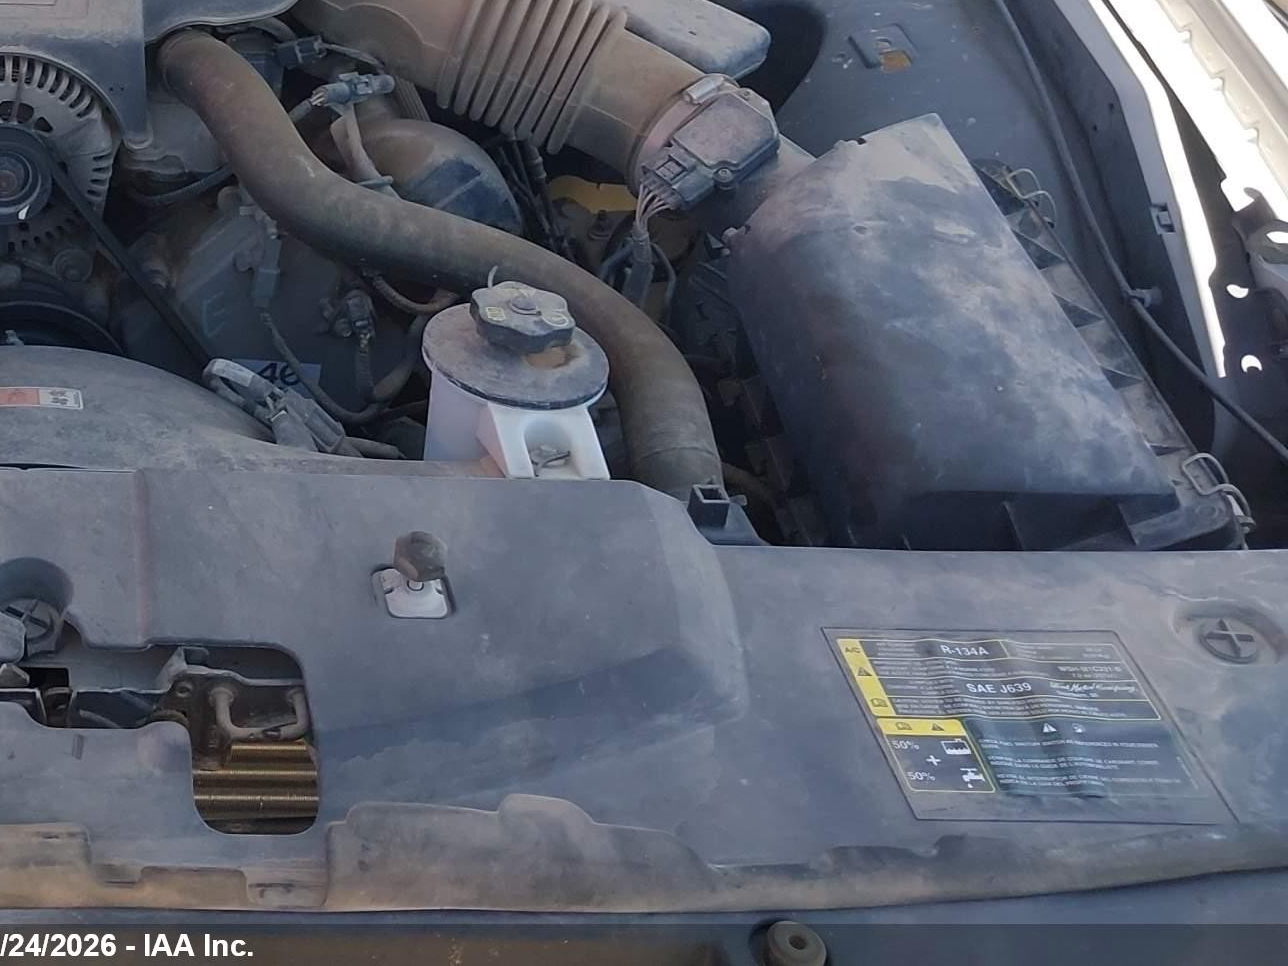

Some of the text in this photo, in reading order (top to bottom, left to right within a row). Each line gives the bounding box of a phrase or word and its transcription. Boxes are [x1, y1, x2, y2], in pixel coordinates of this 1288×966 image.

[940, 644, 990, 657] R-134A
[966, 682, 996, 694] SAE
[1000, 682, 1033, 694] J639
[893, 740, 920, 751] 50%
[908, 771, 937, 782] 50%
